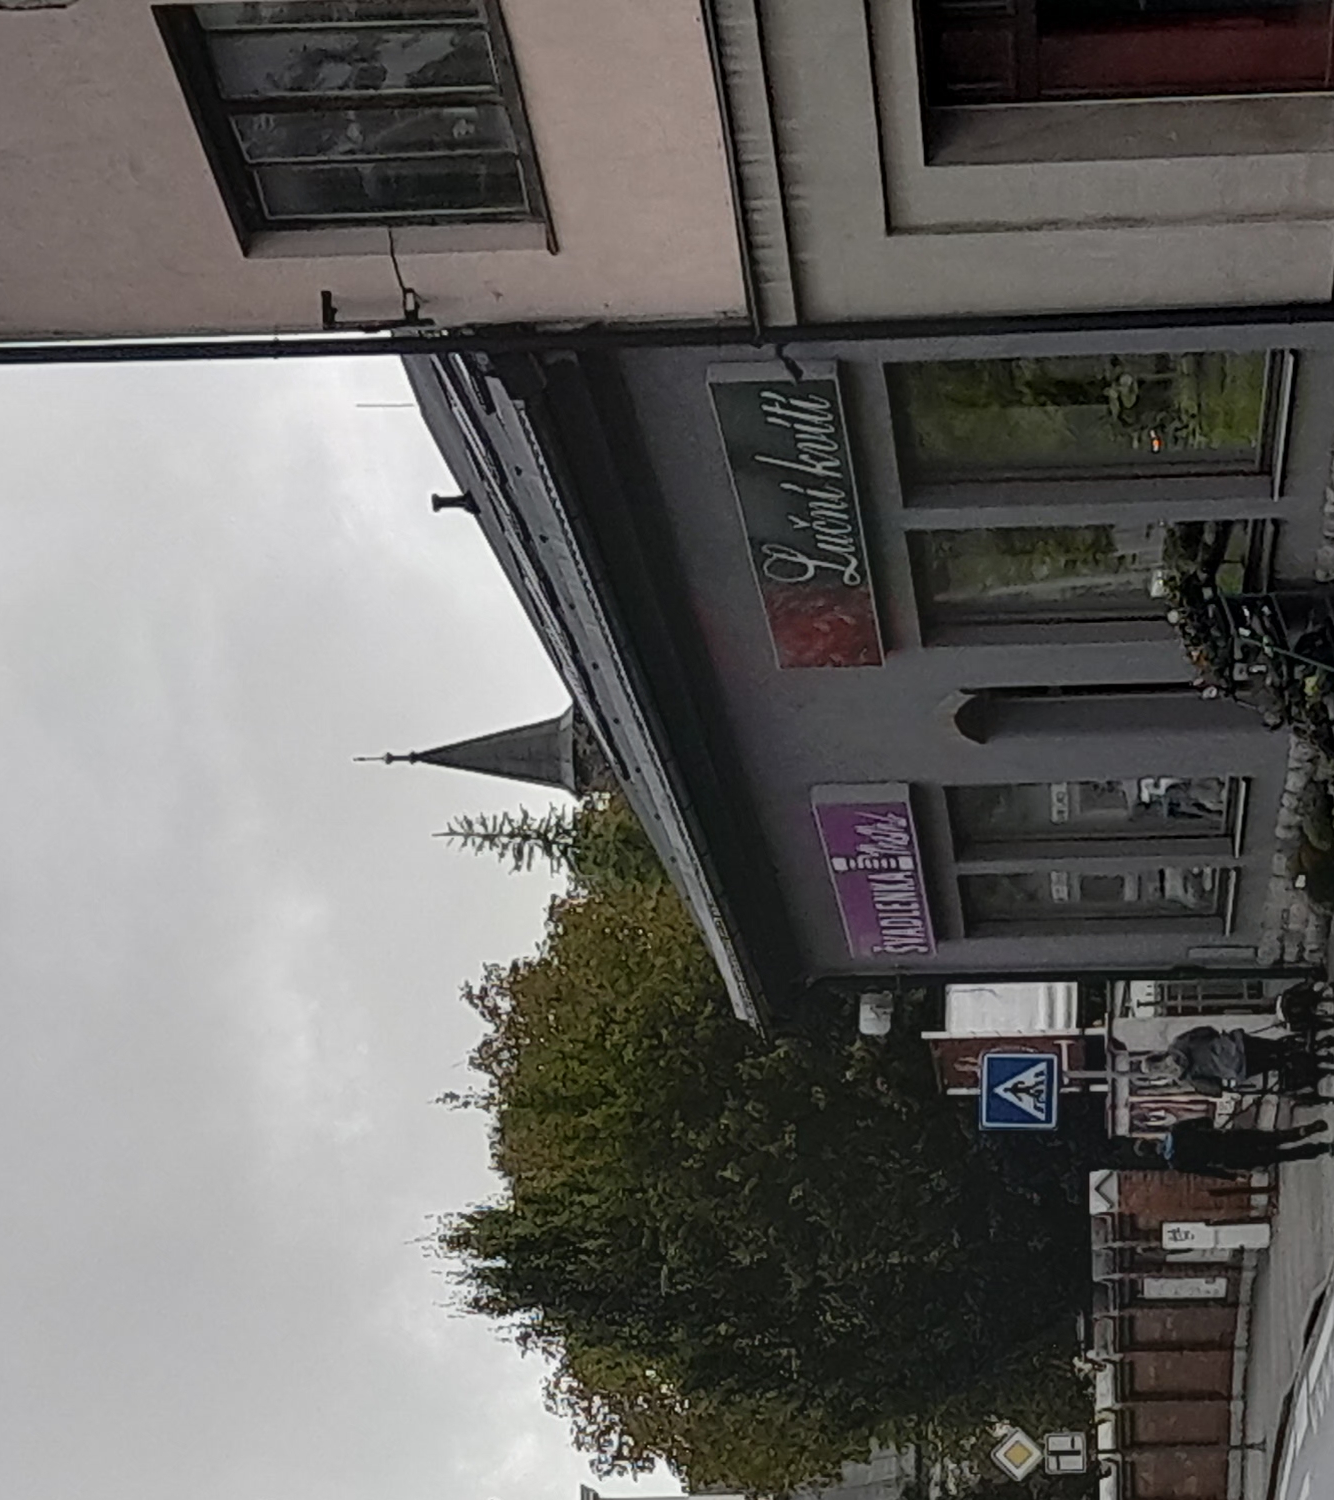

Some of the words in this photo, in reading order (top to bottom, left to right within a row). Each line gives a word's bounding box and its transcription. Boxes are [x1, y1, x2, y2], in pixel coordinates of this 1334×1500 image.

[754, 391, 843, 479] kvítí
[760, 482, 861, 586] Luční
[867, 872, 928, 953] ŠVADLENKA
